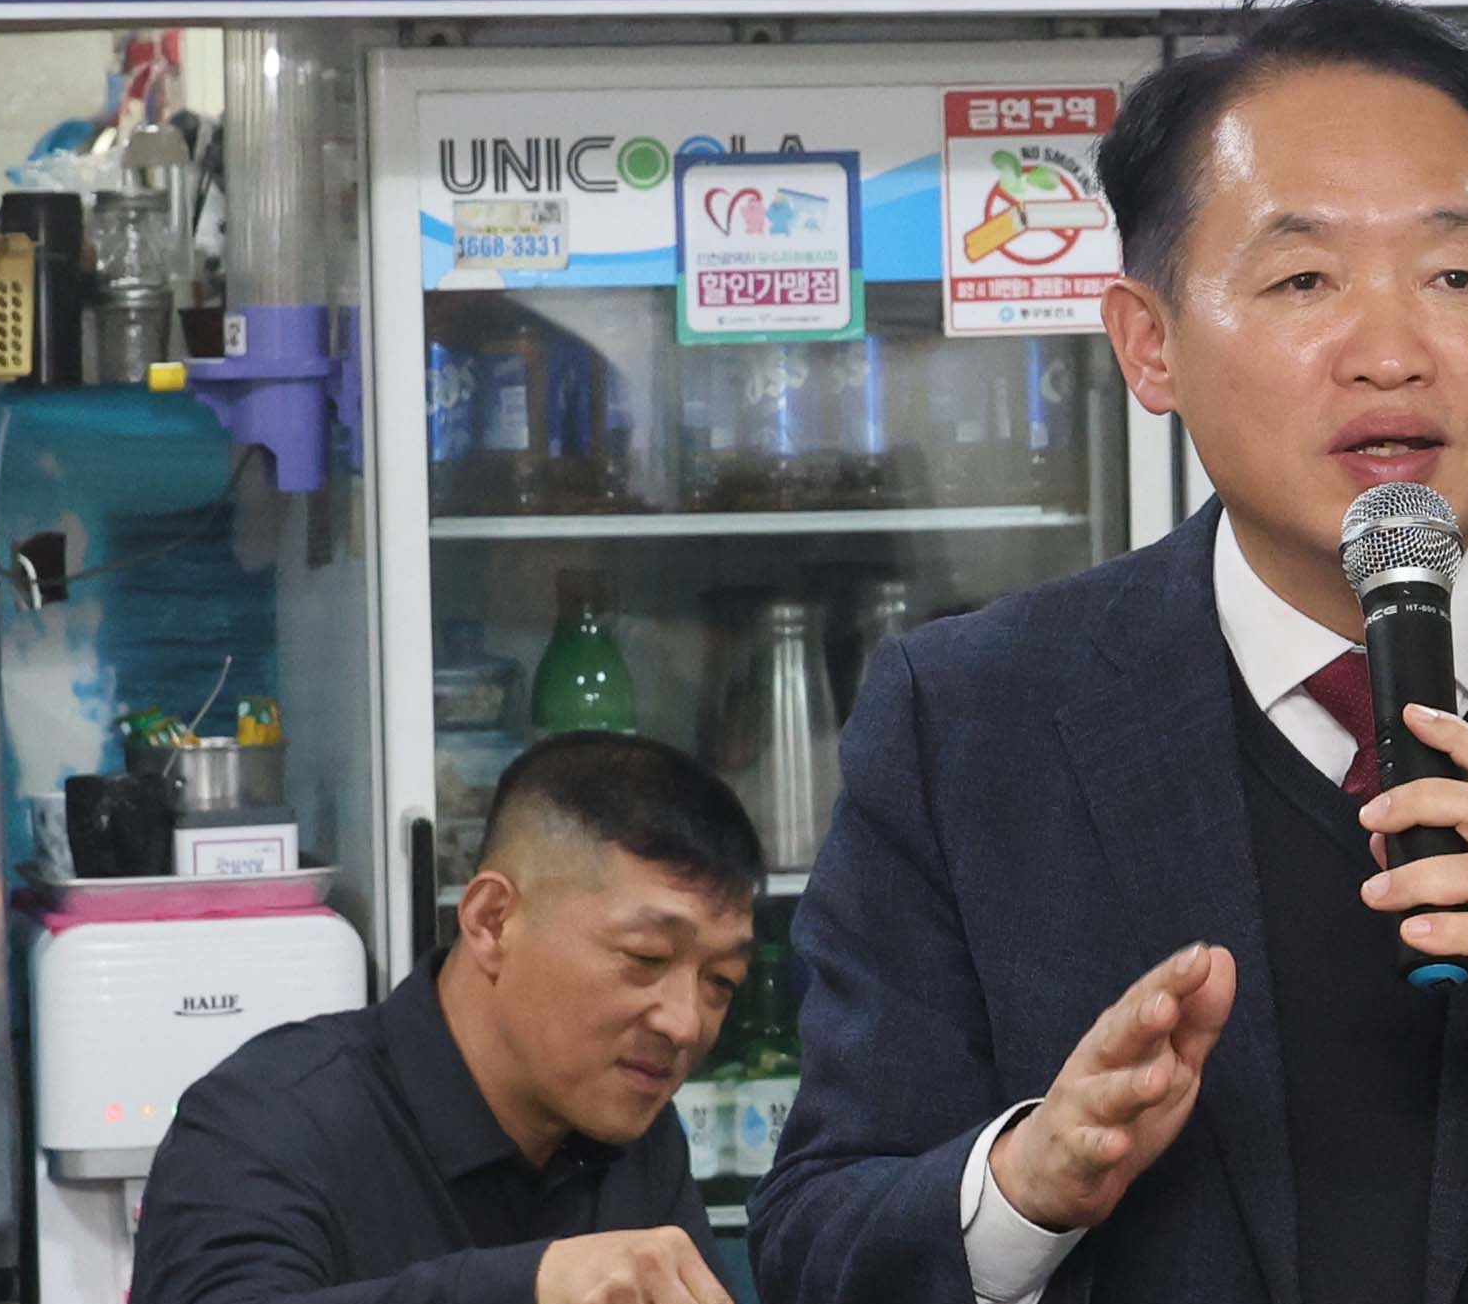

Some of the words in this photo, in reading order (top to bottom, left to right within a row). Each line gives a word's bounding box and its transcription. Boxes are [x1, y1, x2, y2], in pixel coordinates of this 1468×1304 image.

[967, 96, 1096, 131] 금연구역
[439, 134, 806, 195] UNICO
[701, 271, 838, 305] 할인가맹점
